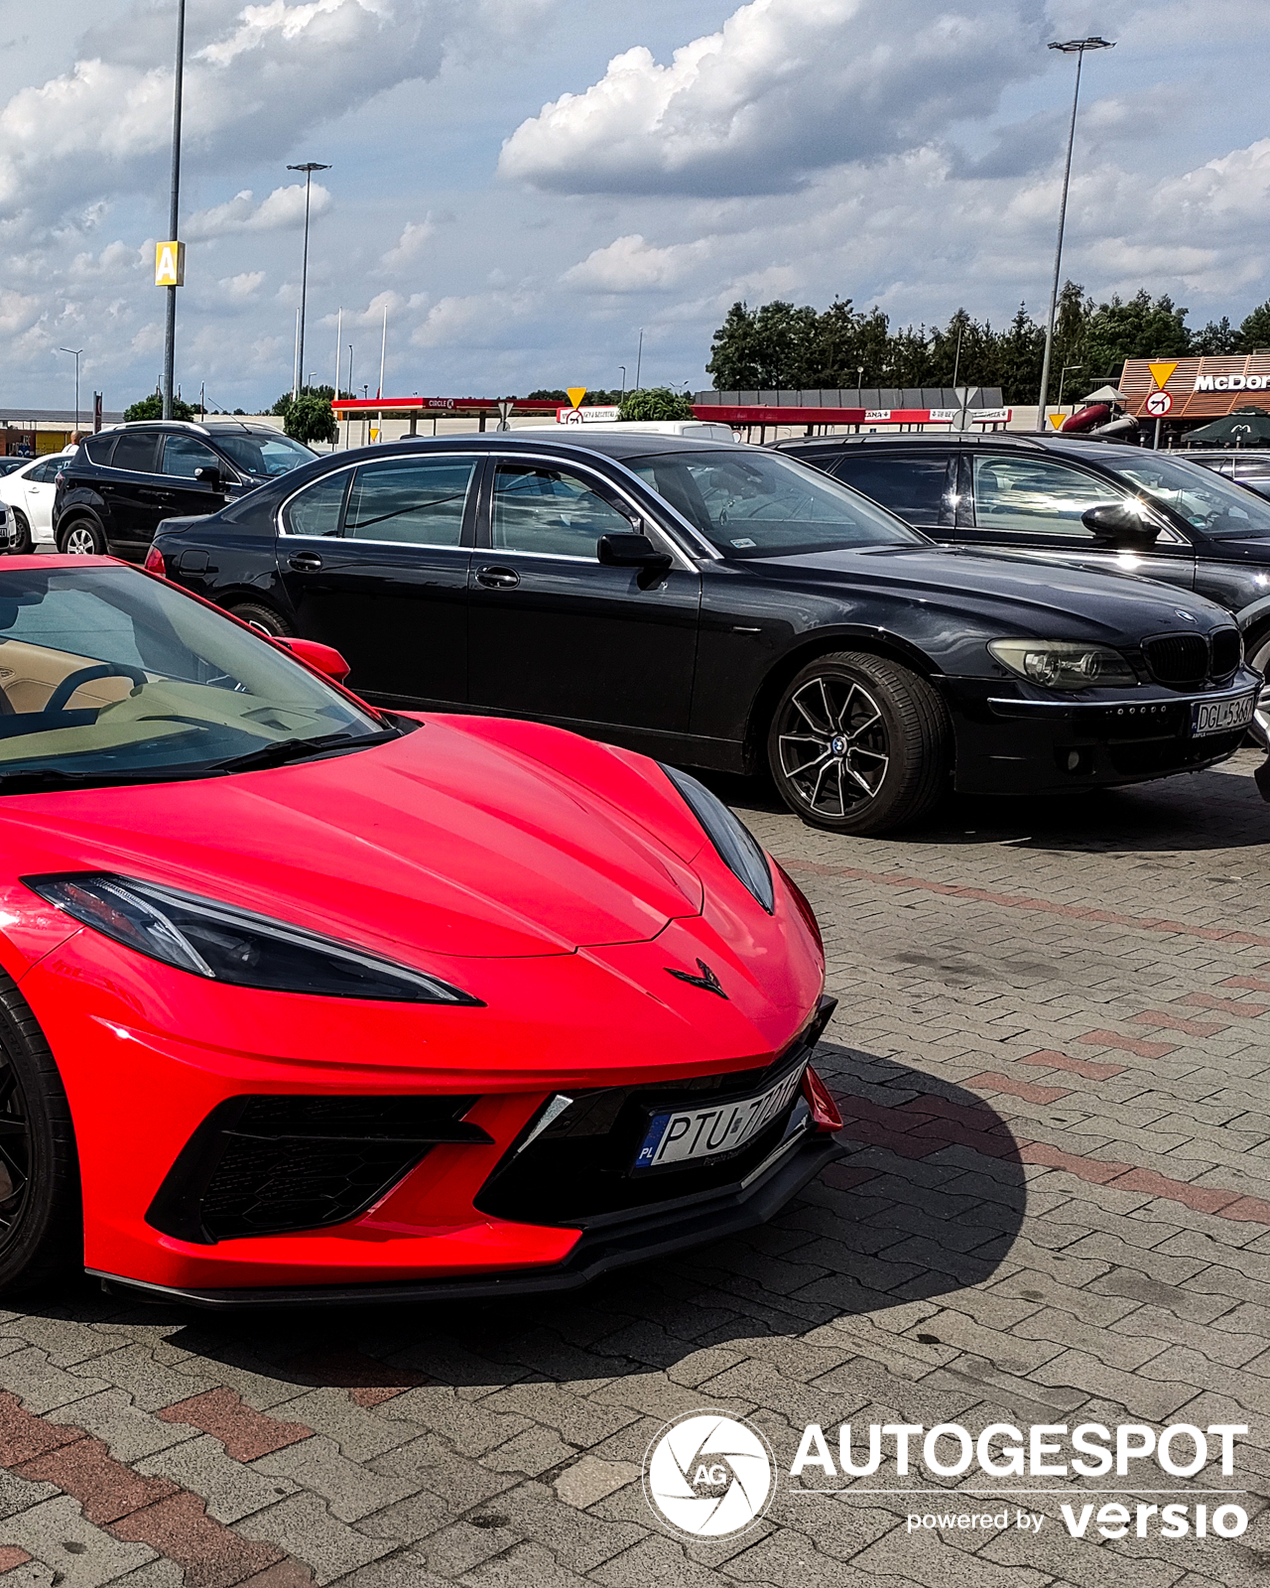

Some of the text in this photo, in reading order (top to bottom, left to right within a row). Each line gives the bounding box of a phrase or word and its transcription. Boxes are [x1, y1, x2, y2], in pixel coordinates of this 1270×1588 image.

[156, 247, 177, 281] A
[1199, 704, 1223, 730] DGL
[657, 1106, 740, 1161] PTU
[638, 1147, 654, 1160] PL
